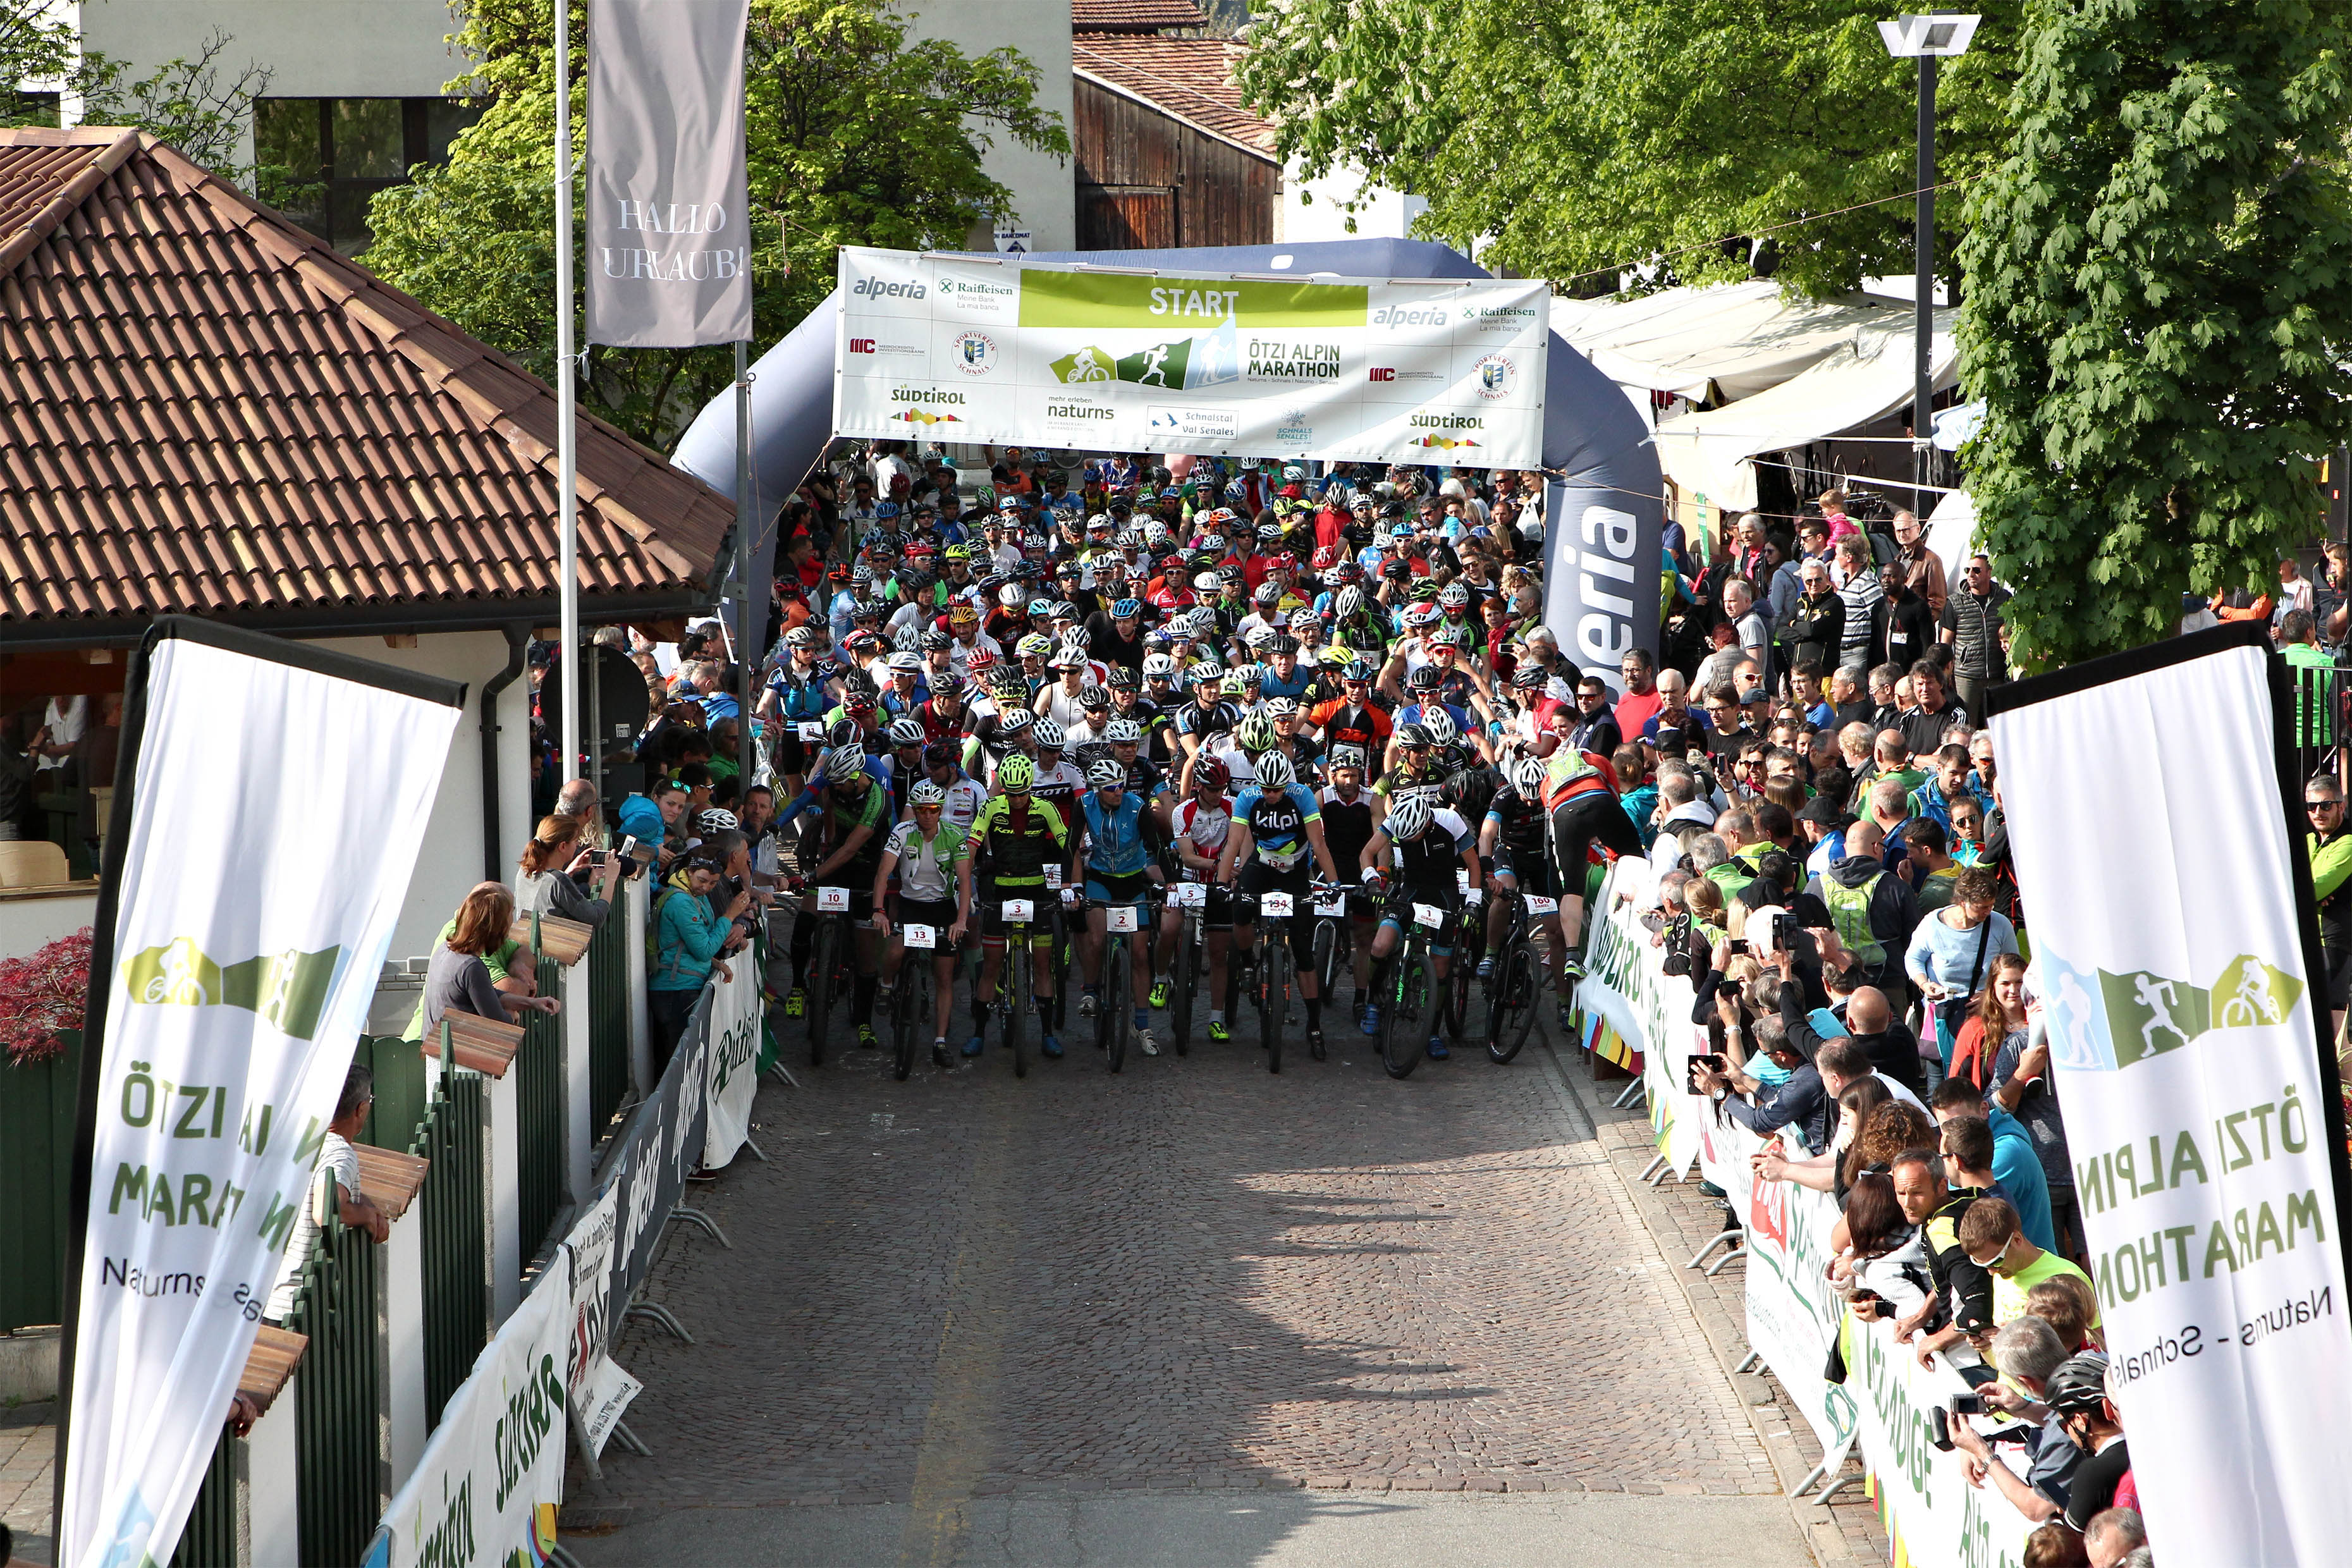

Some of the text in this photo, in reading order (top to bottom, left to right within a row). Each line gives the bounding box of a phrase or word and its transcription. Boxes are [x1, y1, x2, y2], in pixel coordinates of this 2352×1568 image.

[617, 199, 726, 234] HALLO
[601, 246, 744, 281] URLAUB!
[853, 276, 927, 301] alperia
[957, 282, 1014, 296] Raiffeisen
[957, 294, 977, 302] Meine
[1149, 287, 1239, 319] START
[1373, 305, 1448, 330] alperia
[1479, 306, 1536, 317] Raiffeisen
[953, 332, 996, 352] SPORTVEREIN
[1249, 338, 1340, 361] ÖTZI ALPIN
[958, 363, 990, 375] SCHNALS
[1247, 360, 1340, 378] MARATHON
[1473, 355, 1516, 376] SPORTVEREIN
[1476, 388, 1509, 400] SCHNALS
[1048, 403, 1115, 420] naturns
[1185, 412, 1233, 423] Schnalstal
[1182, 426, 1234, 436] Val Senales
[1256, 809, 1299, 831] kilpi
[828, 894, 840, 902] 10
[1187, 890, 1194, 898] 5
[1268, 900, 1287, 909] 134
[1531, 897, 1550, 905] 160
[1014, 905, 1021, 914] 3
[1118, 916, 1125, 924] 2
[1421, 914, 1436, 923] OSWALD
[914, 931, 926, 939] 13
[121, 1060, 226, 1139] ÖTZI
